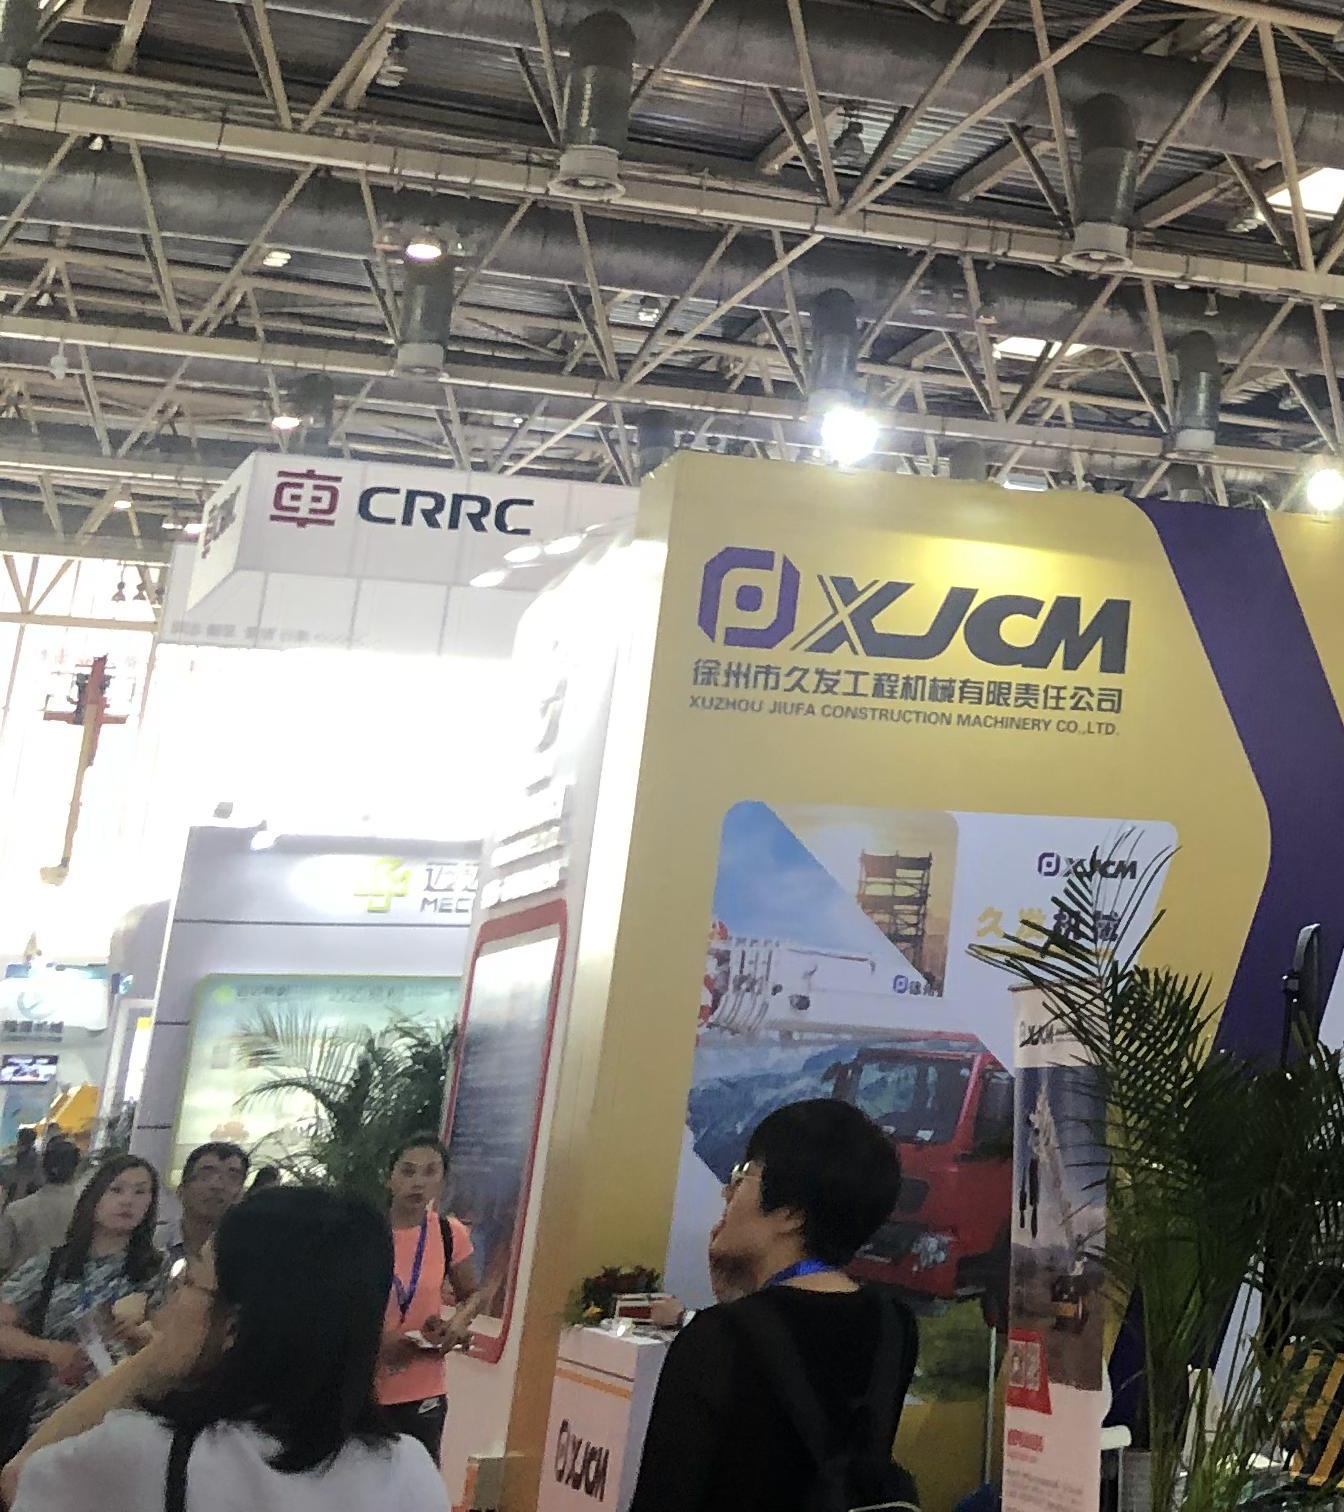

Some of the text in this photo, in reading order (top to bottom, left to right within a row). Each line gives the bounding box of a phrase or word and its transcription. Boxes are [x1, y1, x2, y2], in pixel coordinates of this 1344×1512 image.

[357, 487, 535, 536] CRRC
[790, 574, 1131, 675] XJCM
[692, 658, 1123, 714] 徐州市久发工程机械有限责任公司
[689, 695, 763, 712] XUZHOU
[769, 700, 816, 716] JIUFA
[820, 704, 952, 726] CONSTRUCTION
[956, 713, 1052, 732] MACHINERY
